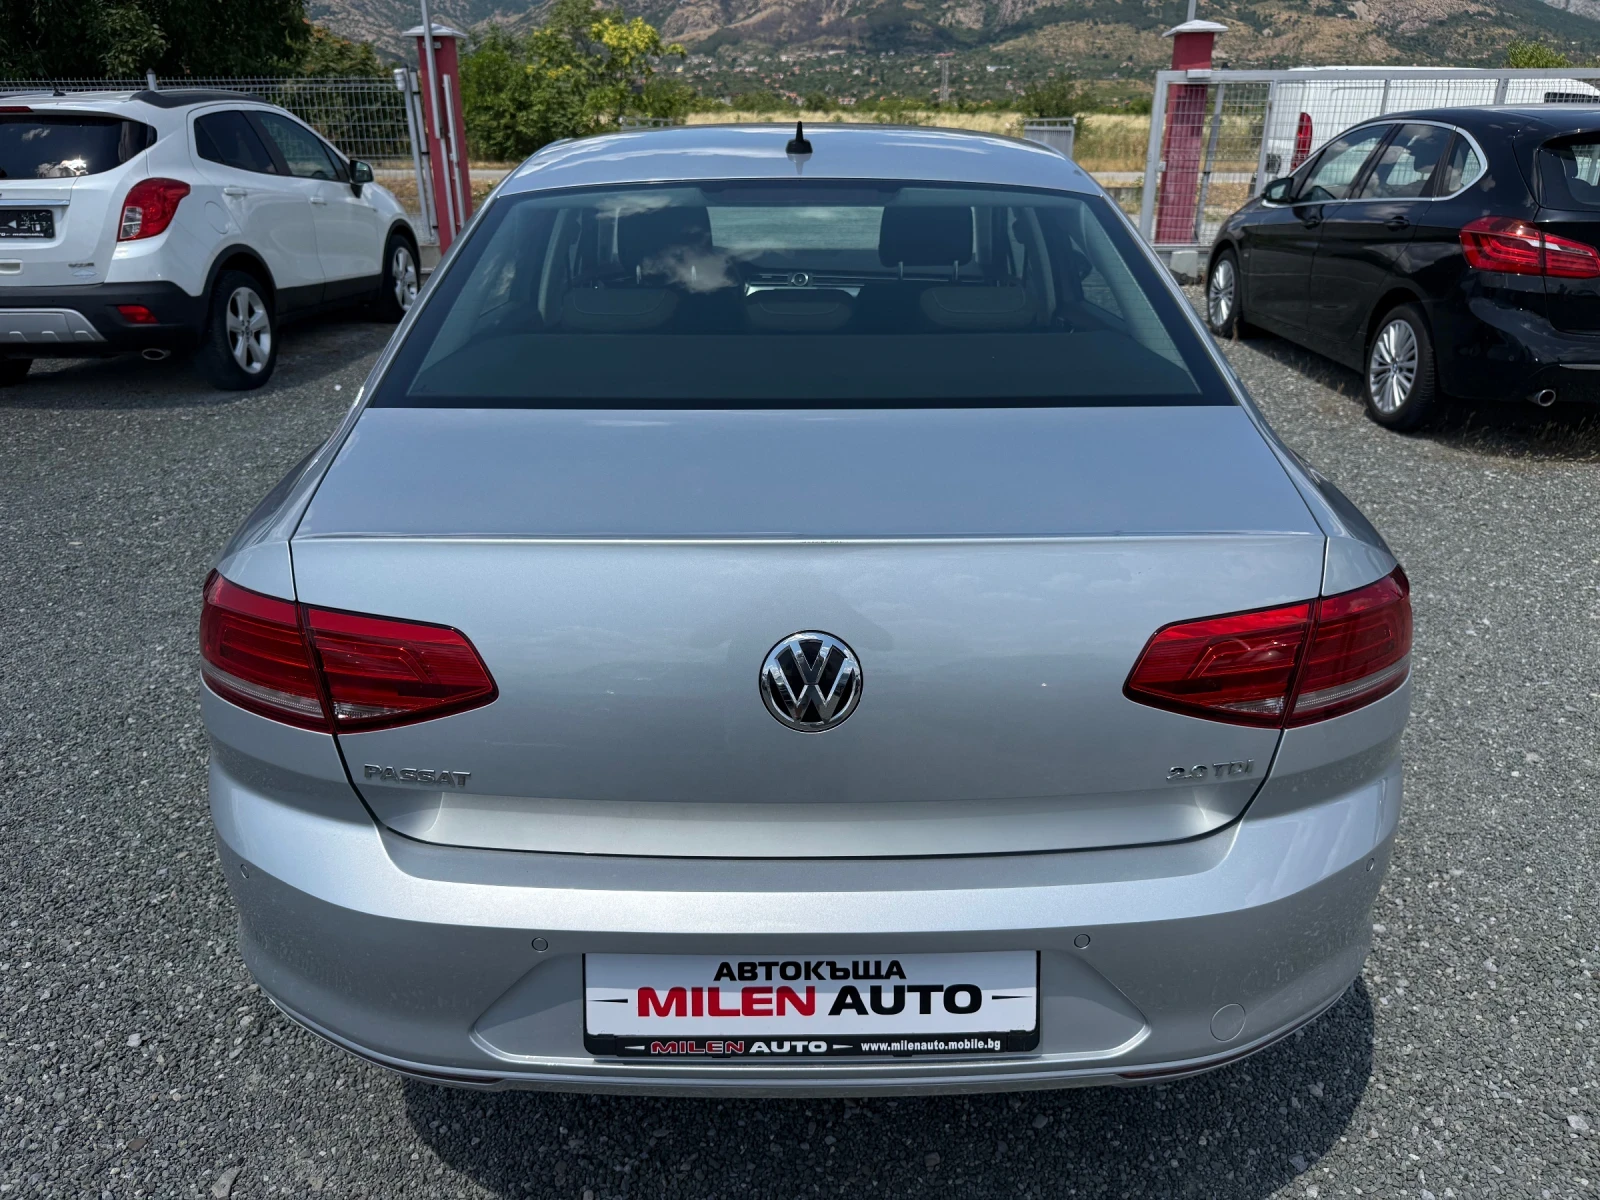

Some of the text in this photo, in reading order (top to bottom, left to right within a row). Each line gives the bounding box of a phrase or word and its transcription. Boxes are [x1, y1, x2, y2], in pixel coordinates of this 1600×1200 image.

[364, 763, 471, 788] PASSAT
[1212, 759, 1255, 778] TDI
[637, 984, 982, 1017] MILEN AUTO
[650, 1038, 1001, 1054] MILEN AUTO www.milenauto.mobile.bg
